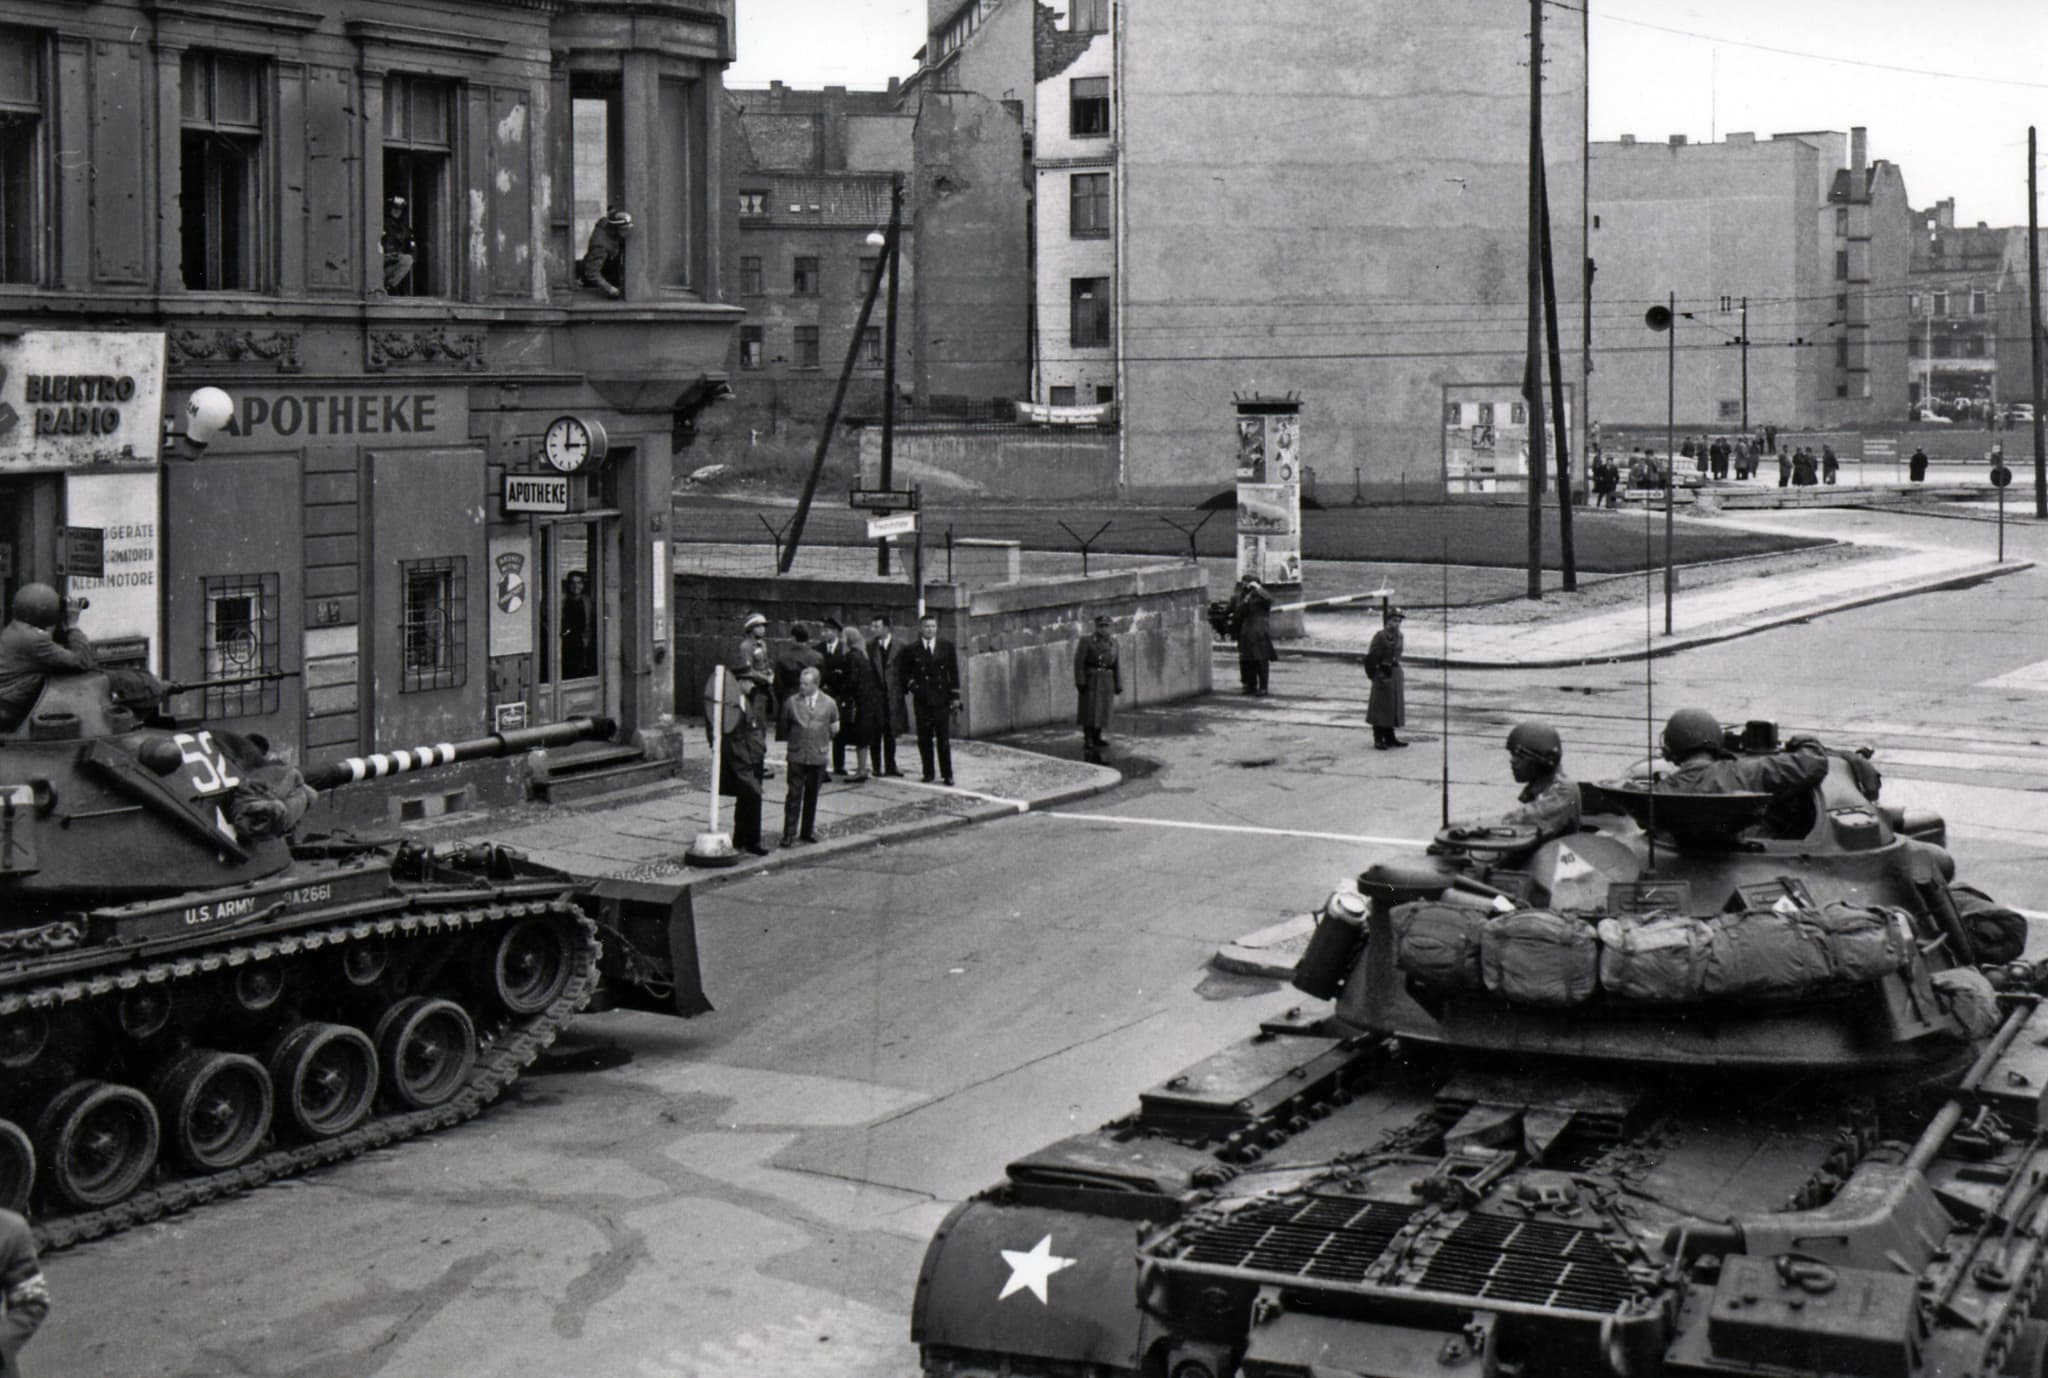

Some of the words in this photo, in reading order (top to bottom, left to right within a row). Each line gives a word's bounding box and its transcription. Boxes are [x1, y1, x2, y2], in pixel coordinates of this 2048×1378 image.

[26, 374, 135, 403] ELEKTRO
[35, 406, 121, 435] RADIO
[508, 482, 565, 504] APOTHEKE
[173, 731, 240, 793] 52
[185, 905, 212, 925] U.S.
[216, 897, 256, 919] ARMY
